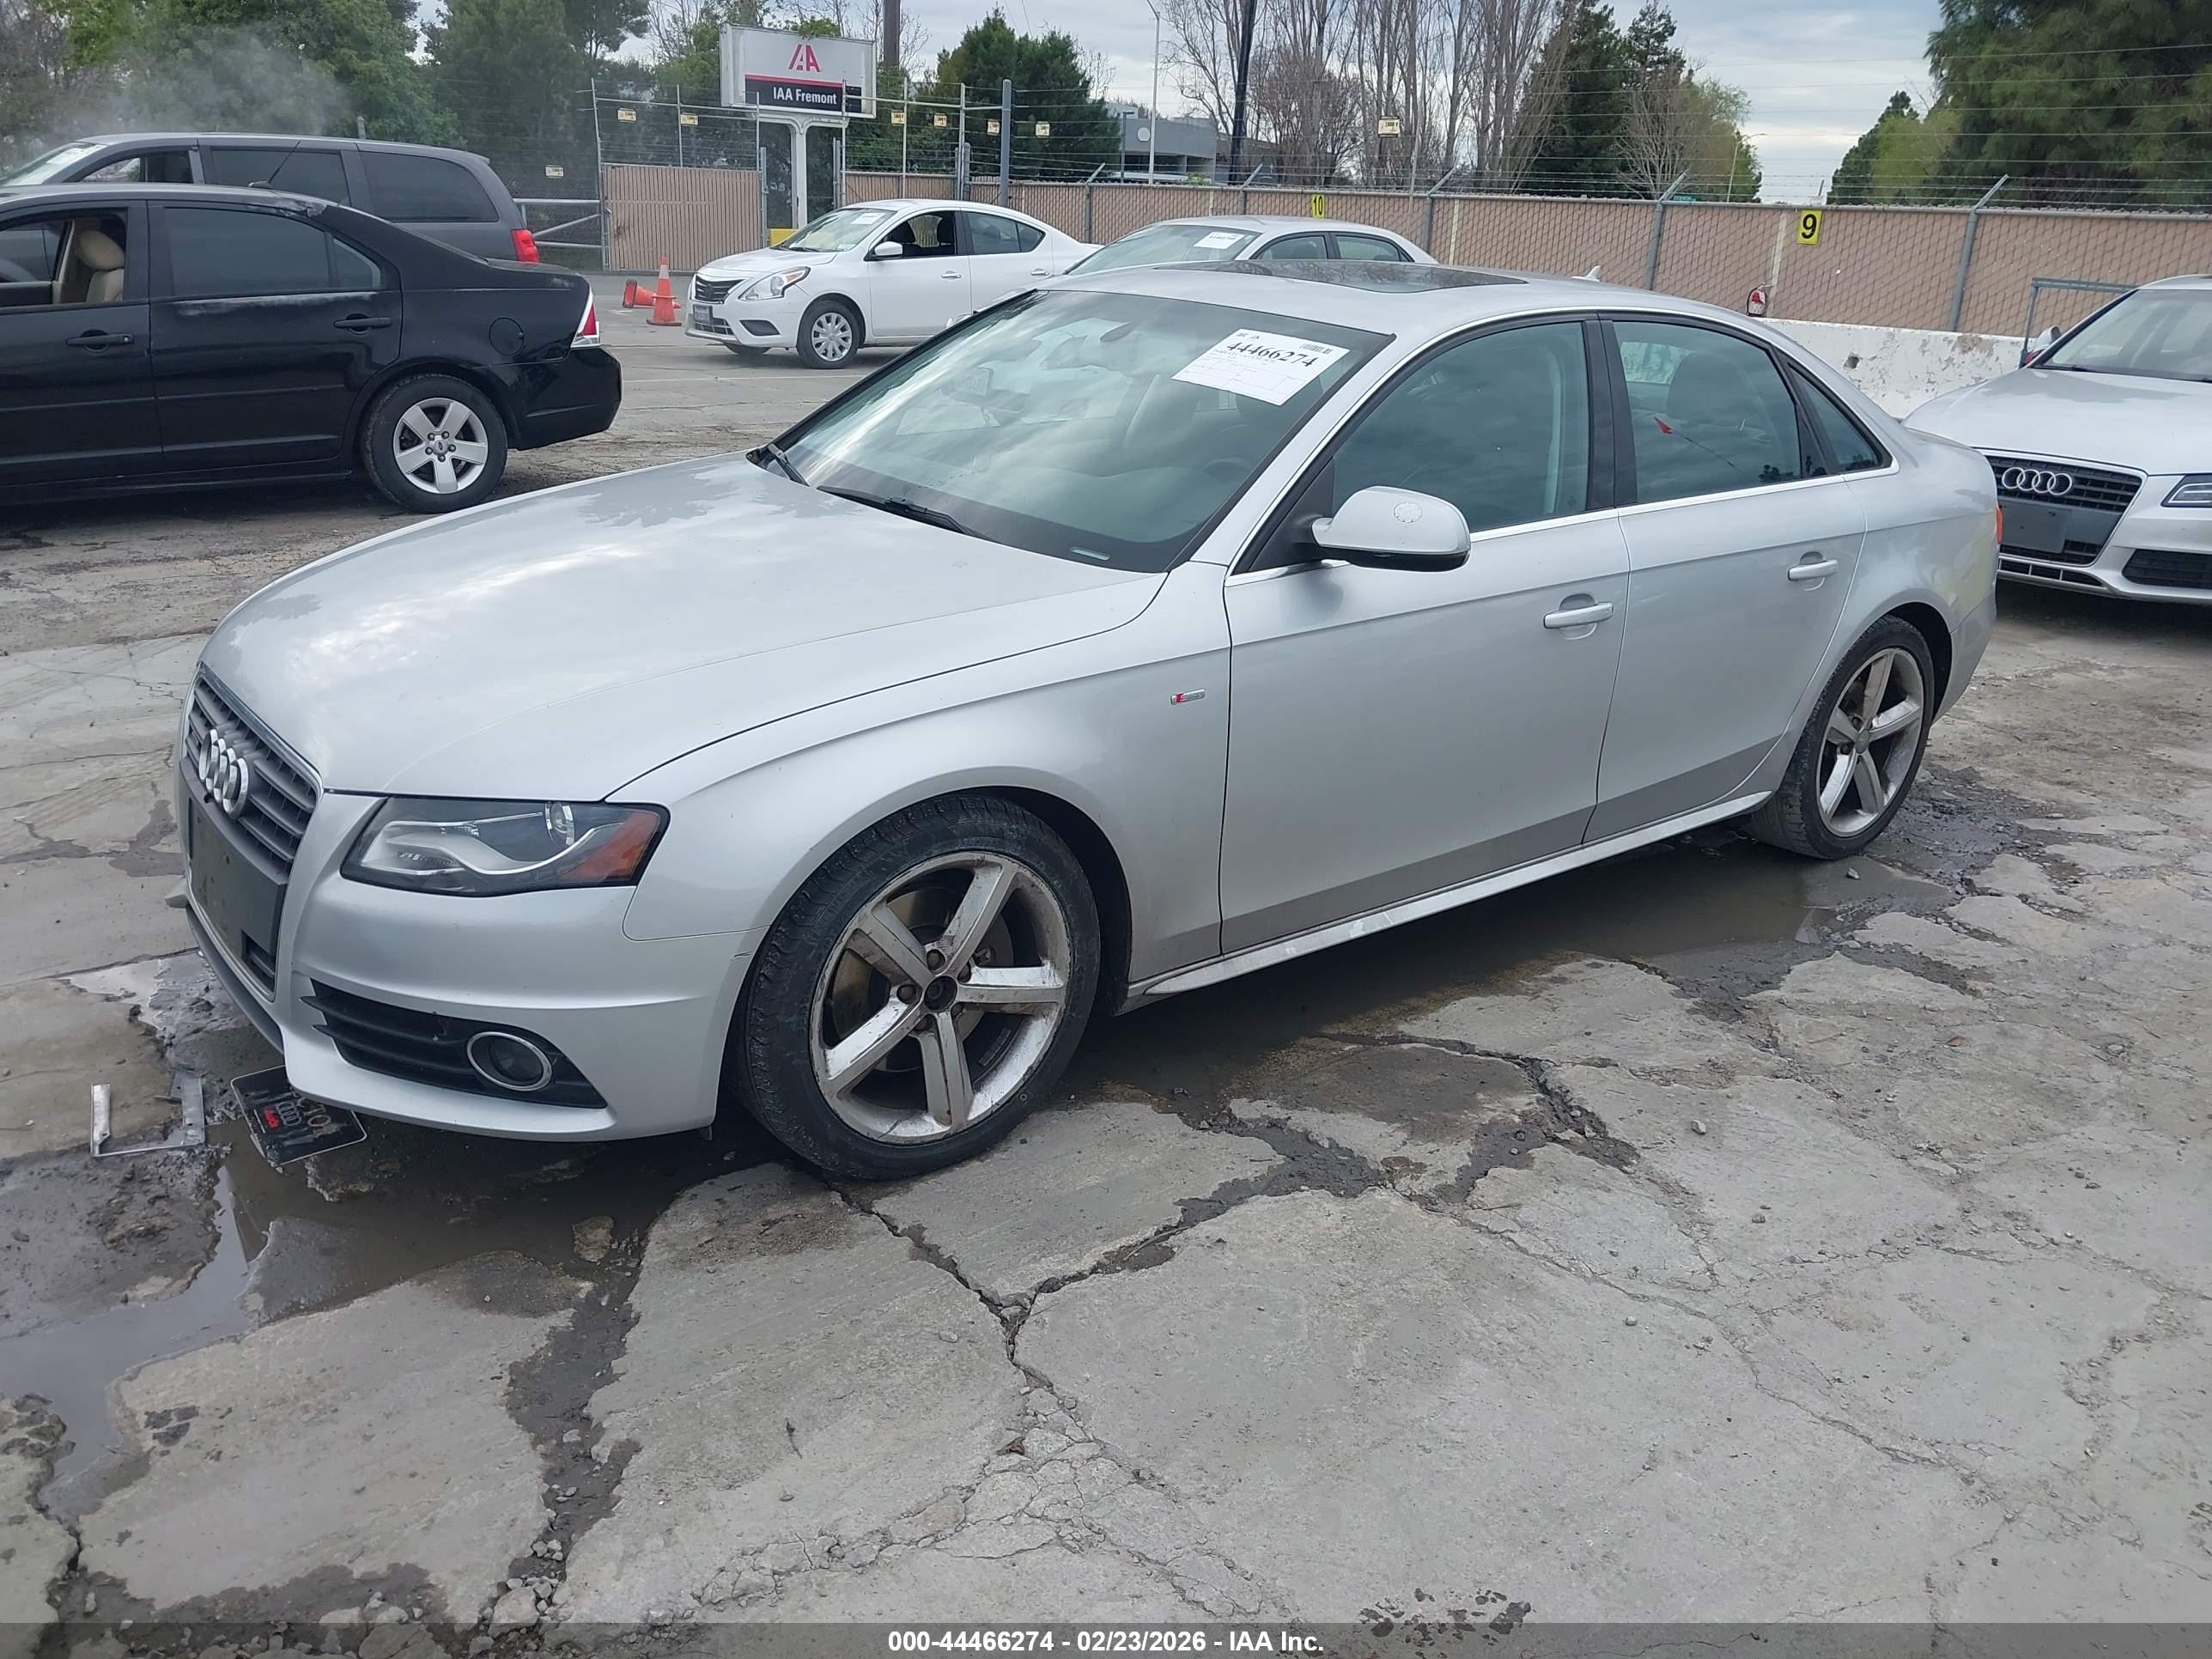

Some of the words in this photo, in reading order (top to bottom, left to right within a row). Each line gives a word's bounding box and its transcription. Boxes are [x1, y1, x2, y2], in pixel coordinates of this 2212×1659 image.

[773, 86, 793, 101] IAA
[795, 88, 837, 105] Fremont
[1313, 195, 1323, 216] 10
[1801, 213, 1817, 240] 9
[1227, 342, 1319, 367] 44466274
